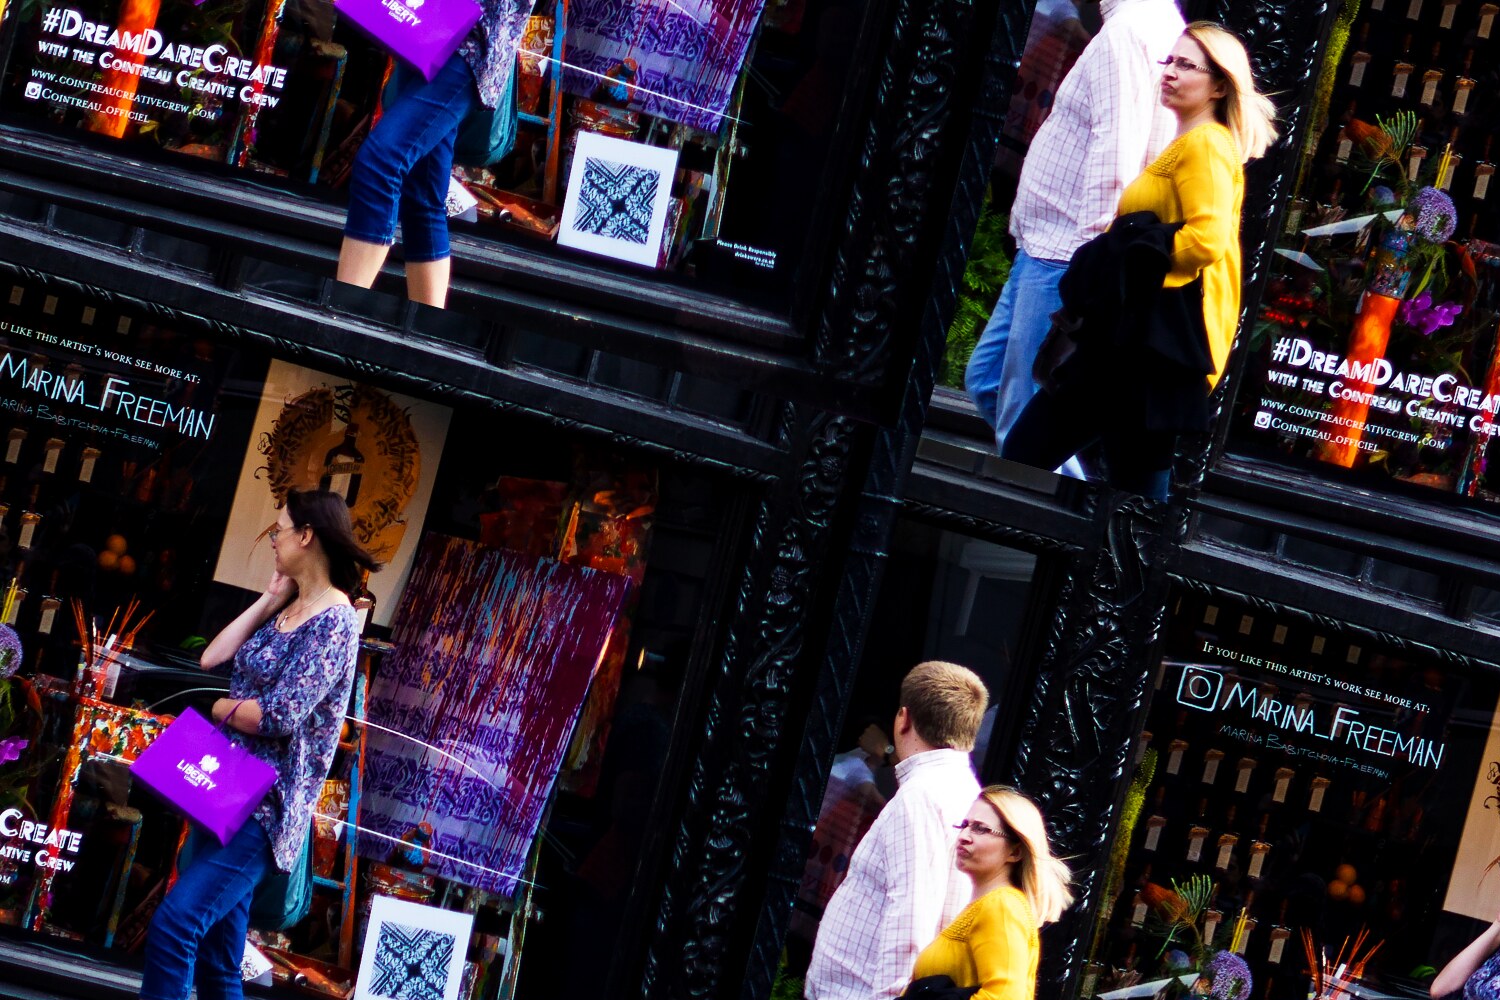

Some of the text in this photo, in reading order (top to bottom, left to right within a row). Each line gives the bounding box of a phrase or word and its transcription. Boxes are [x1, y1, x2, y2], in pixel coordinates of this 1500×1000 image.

[717, 240, 732, 248] Please
[748, 247, 776, 259] Responsibly
[0, 396, 32, 413] ARINA
[176, 759, 216, 790] LIBERTY
[0, 845, 31, 863] ATIVE
